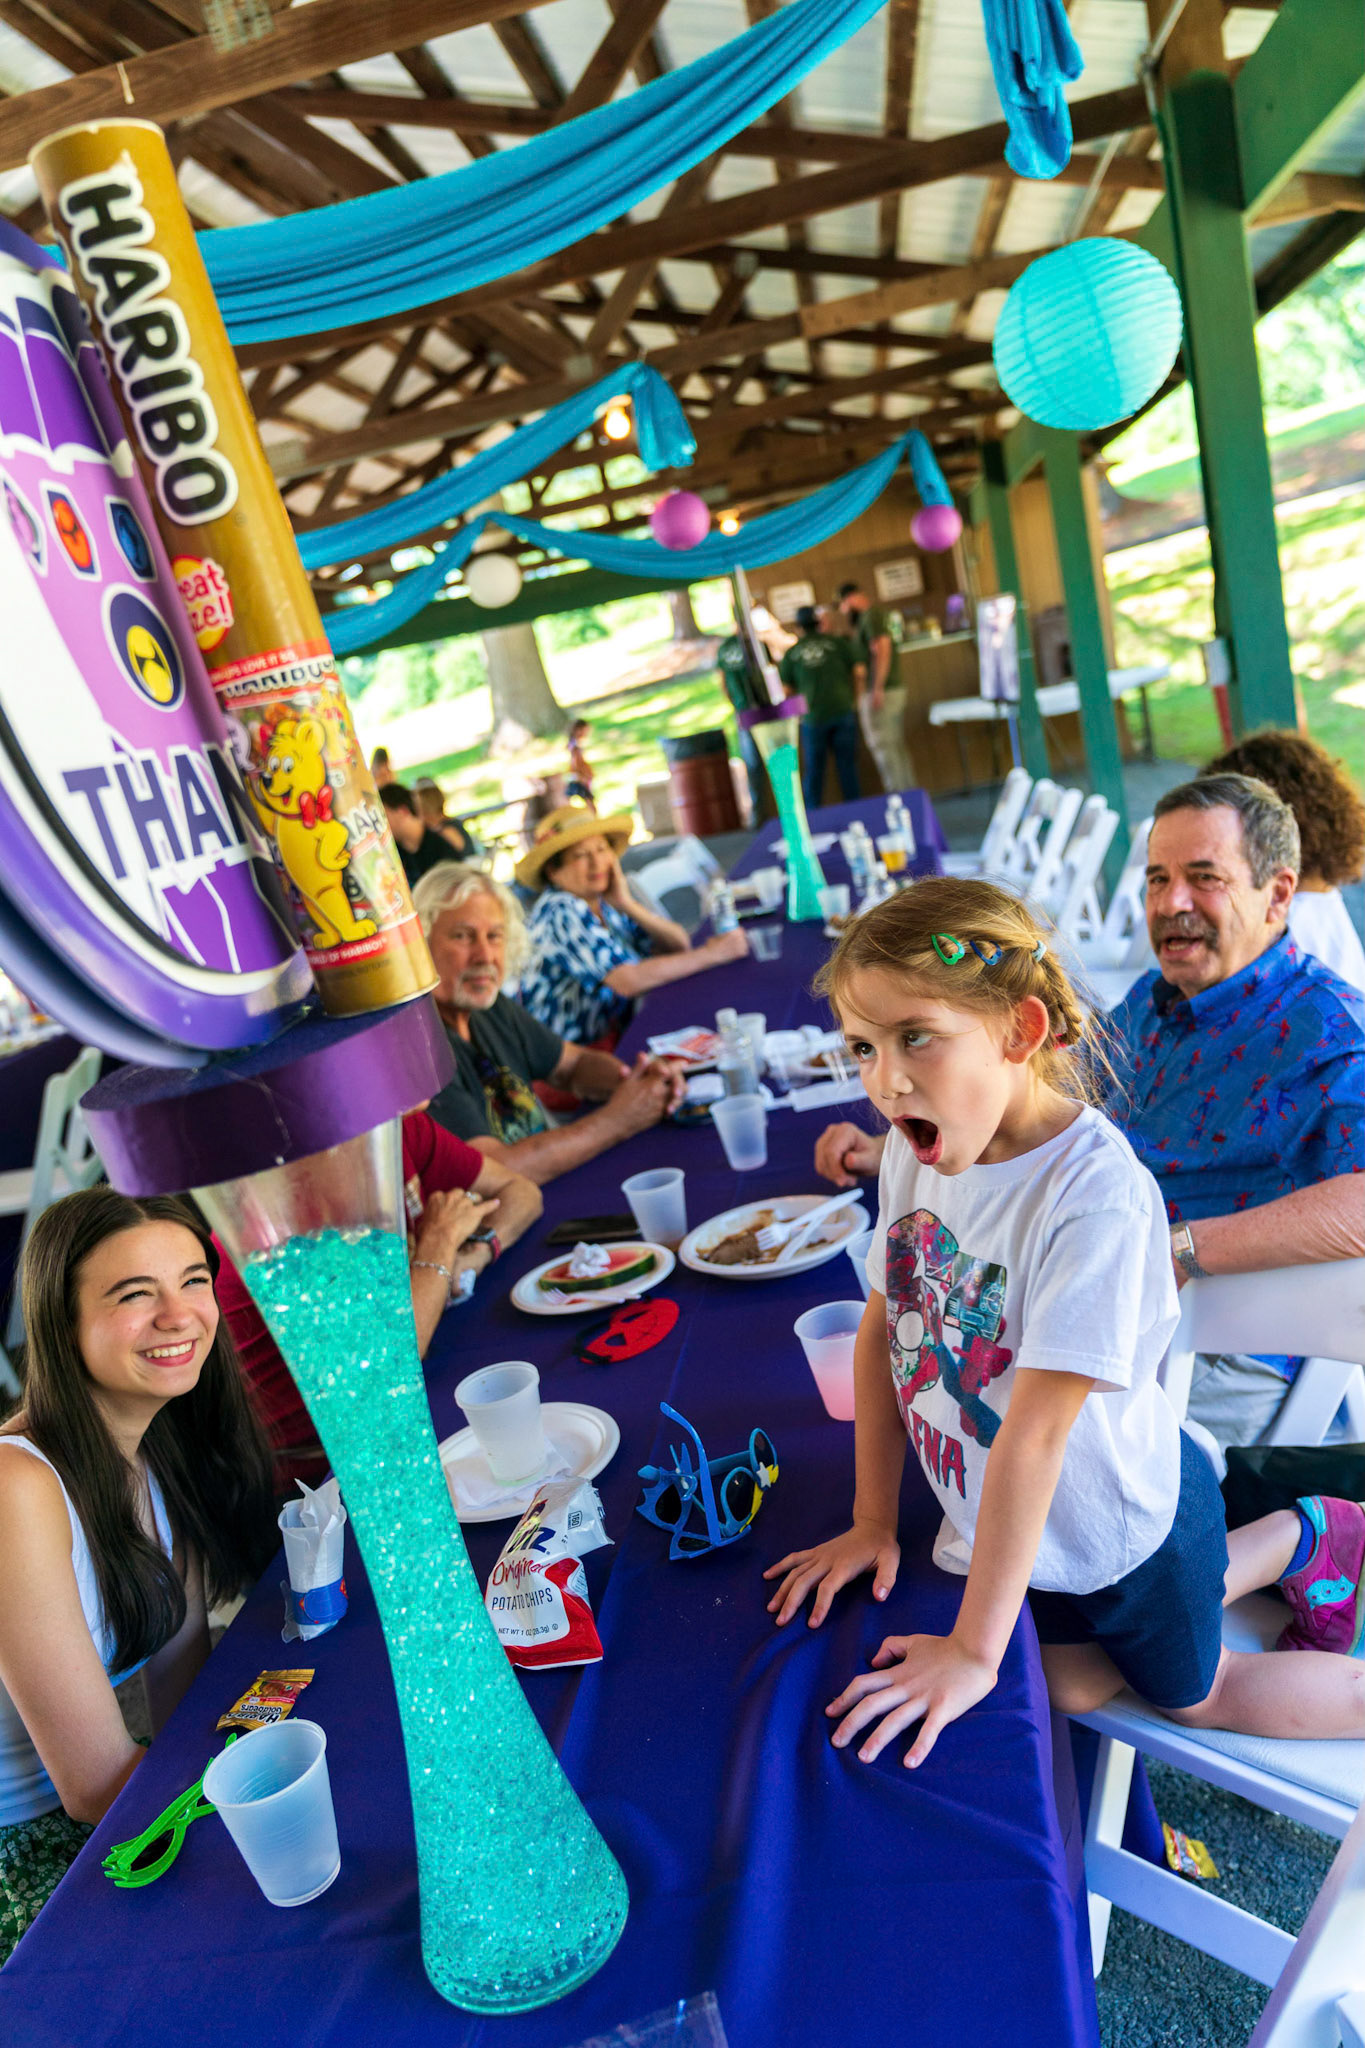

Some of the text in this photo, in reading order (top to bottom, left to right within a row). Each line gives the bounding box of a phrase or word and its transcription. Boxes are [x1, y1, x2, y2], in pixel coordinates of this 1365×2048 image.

[63, 180, 230, 519] HARIBO
[178, 563, 223, 603] eat
[191, 594, 230, 634] ze!
[61, 748, 270, 880] THAN
[908, 1407, 967, 1500] ENA
[492, 1557, 552, 1590] Origina
[491, 1587, 553, 1611] POTATO CHIPS
[498, 1627, 510, 1635] NET
